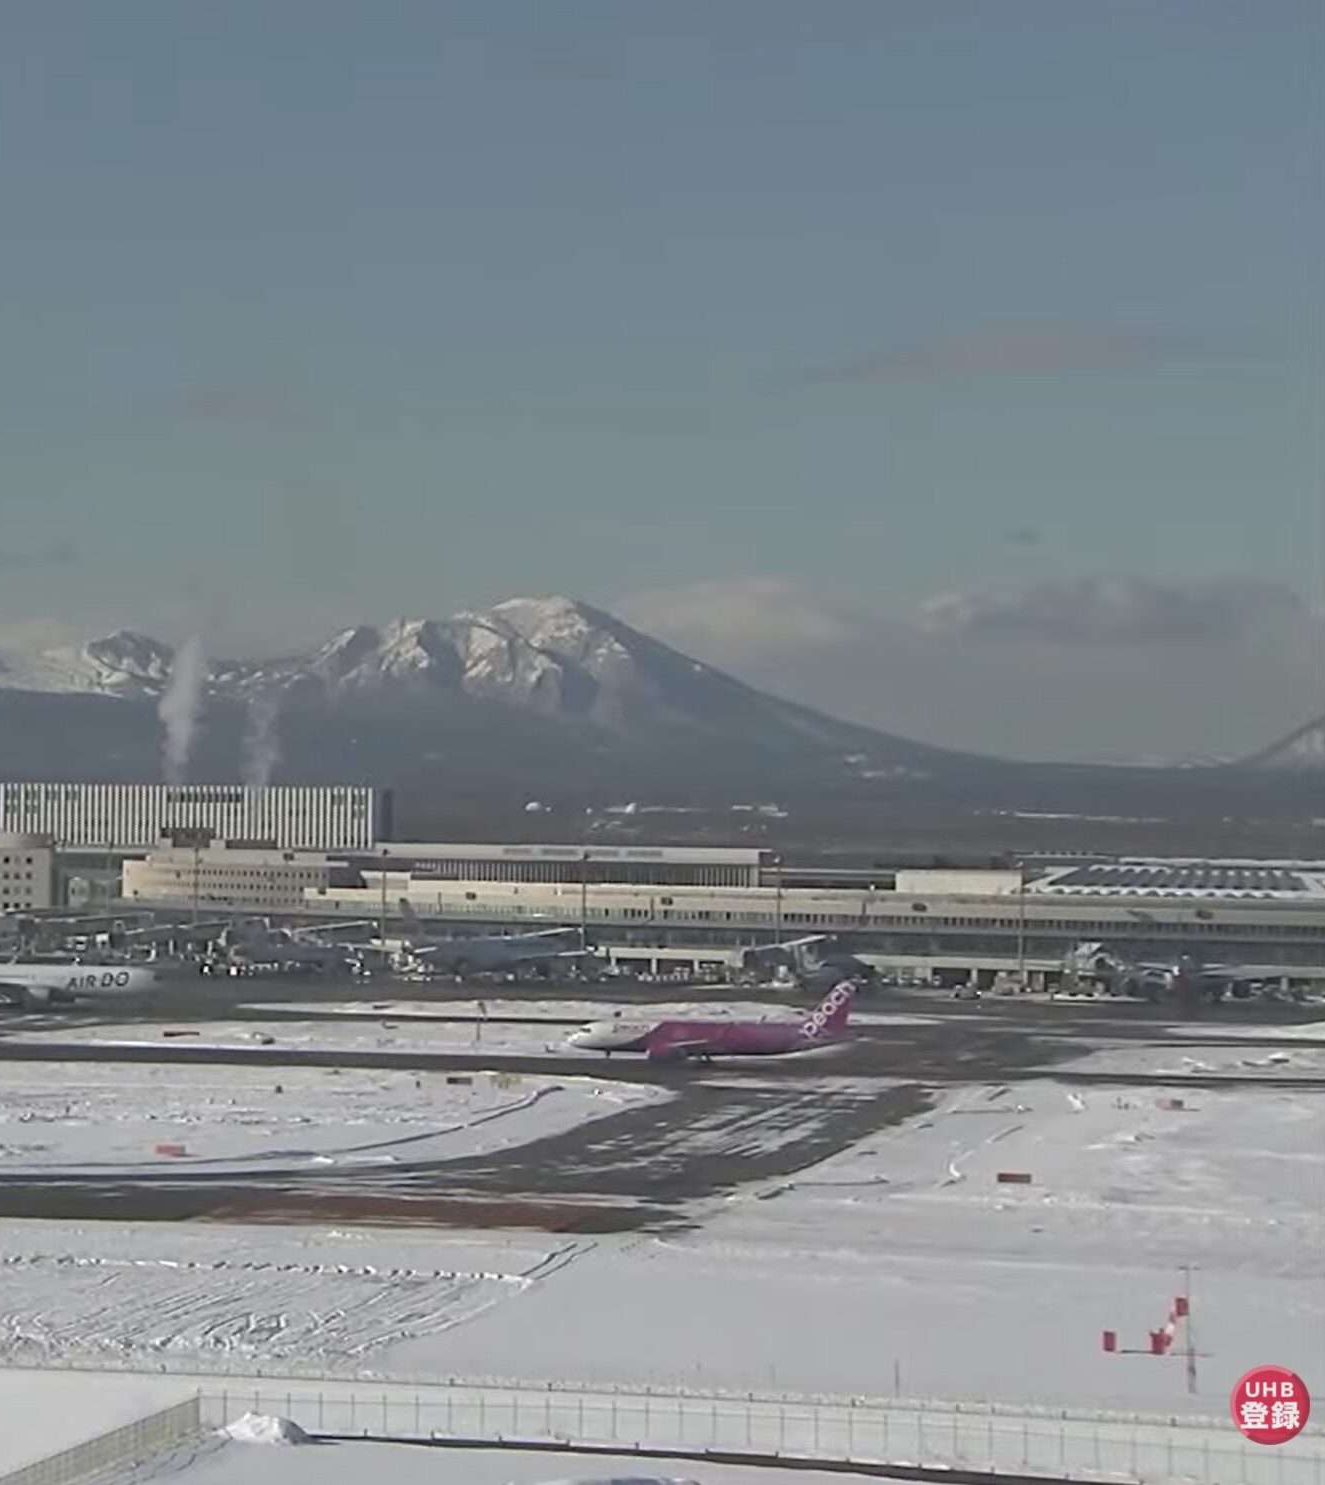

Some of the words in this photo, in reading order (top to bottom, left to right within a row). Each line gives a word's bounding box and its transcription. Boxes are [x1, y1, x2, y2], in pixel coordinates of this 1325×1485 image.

[66, 974, 96, 991] AIR
[100, 971, 130, 987] DO
[798, 982, 856, 1039] peach
